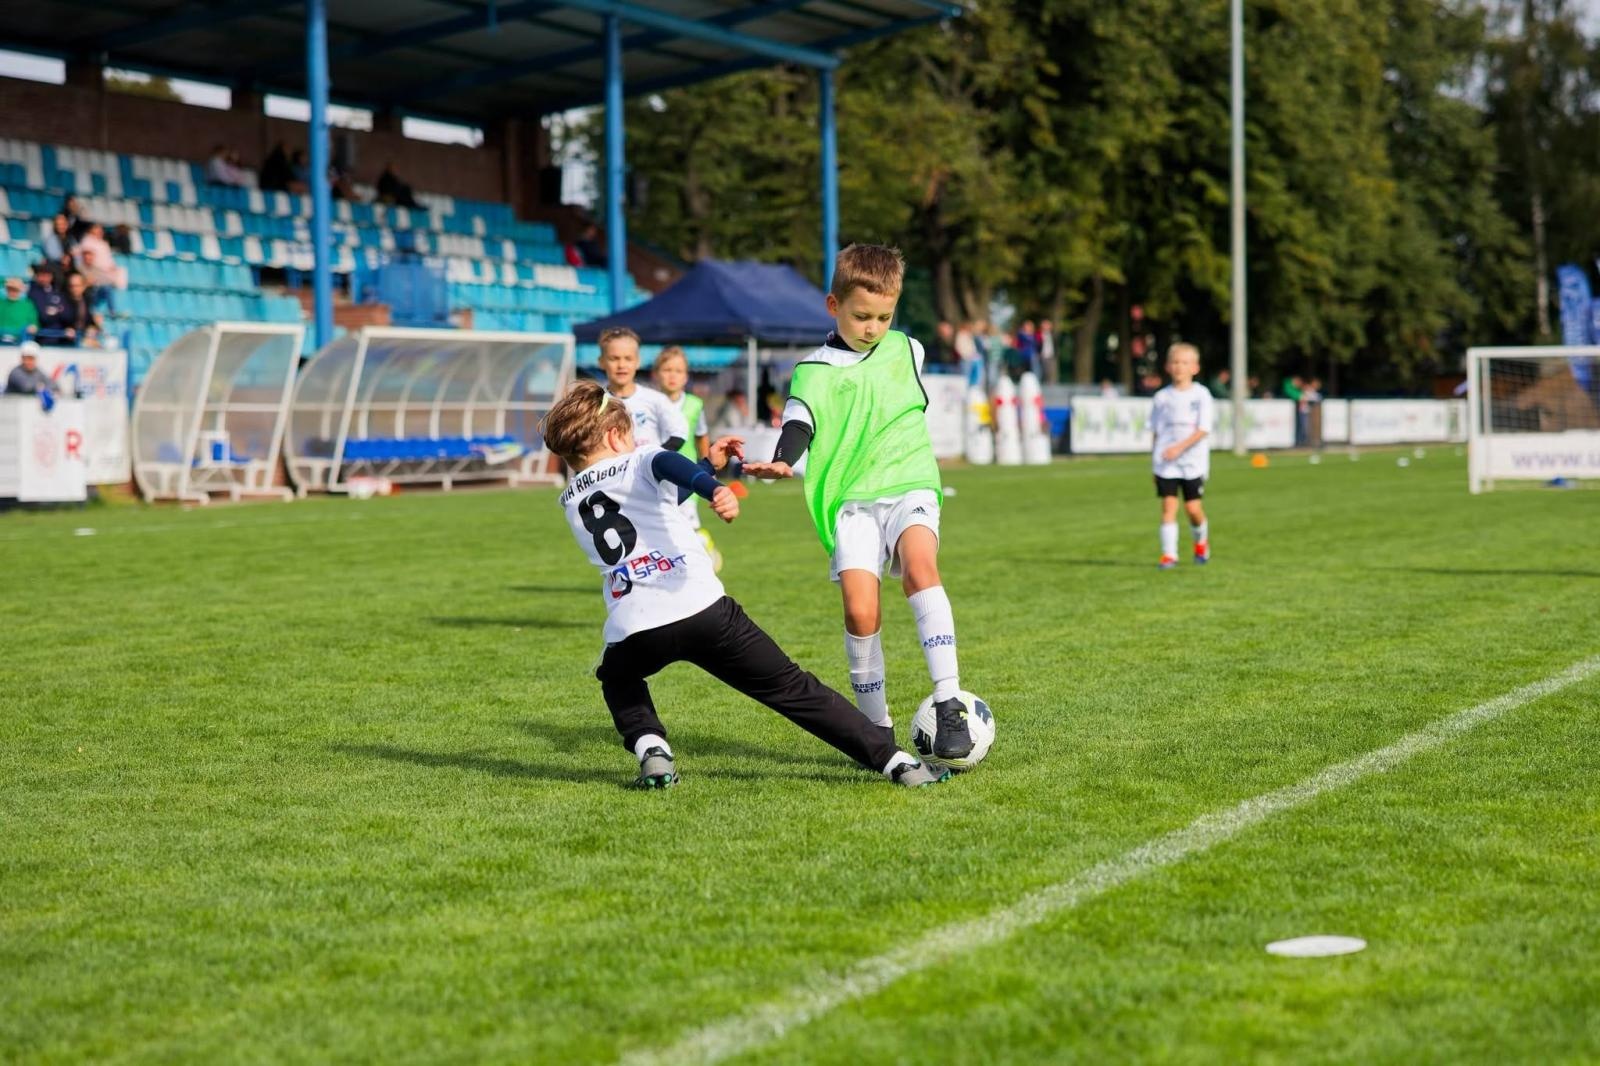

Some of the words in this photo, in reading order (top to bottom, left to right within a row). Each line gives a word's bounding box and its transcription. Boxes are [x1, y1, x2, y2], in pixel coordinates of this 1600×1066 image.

[578, 490, 637, 566] 8
[630, 550, 664, 570] PRO
[633, 554, 688, 580] SPORT
